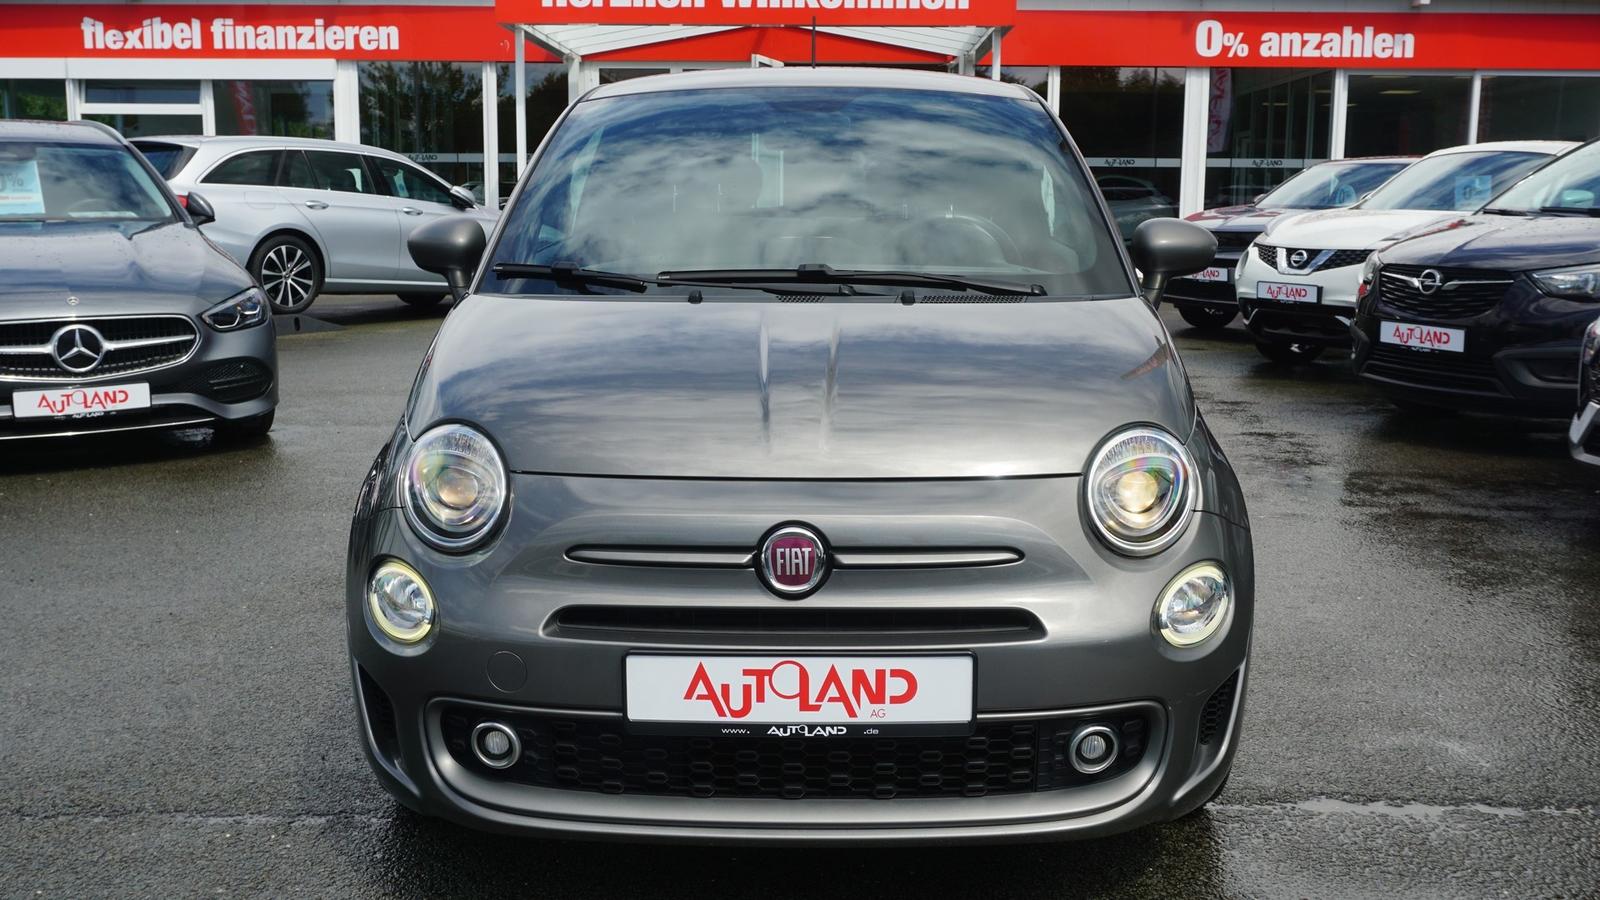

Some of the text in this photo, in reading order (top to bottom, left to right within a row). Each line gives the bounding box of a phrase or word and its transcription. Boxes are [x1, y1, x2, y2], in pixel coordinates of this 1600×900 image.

[81, 17, 399, 50] flexibel finanzieren
[1195, 20, 1415, 59] 0% anzahlen
[1266, 284, 1308, 299] AUTOLAND
[1393, 325, 1451, 347] AUTOLAND
[38, 390, 129, 413] AUTOLAND
[776, 547, 812, 576] FIAT
[683, 660, 918, 718] AUTOLAND
[870, 708, 886, 718] AG
[767, 724, 847, 737] AUTOLAND
